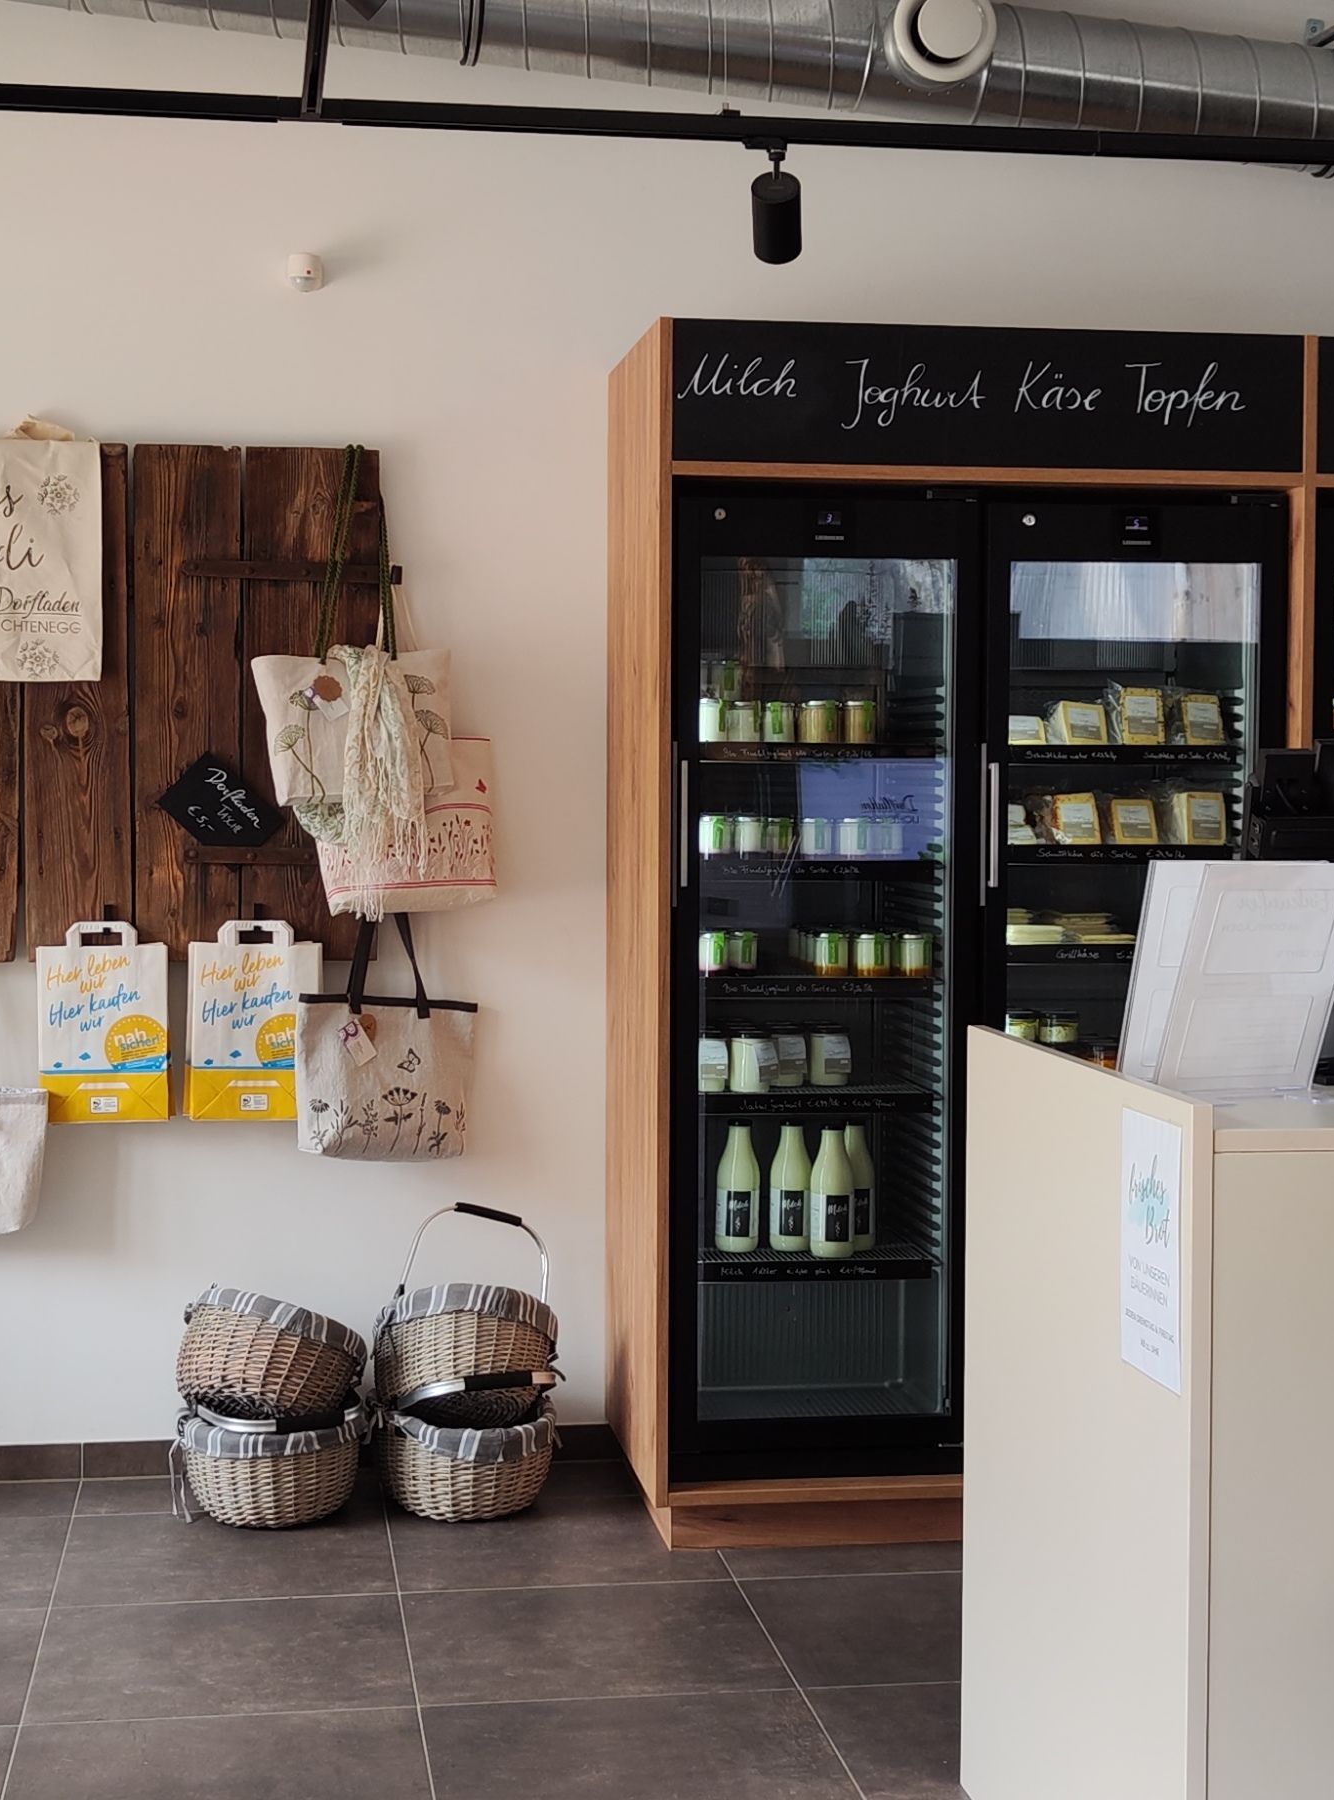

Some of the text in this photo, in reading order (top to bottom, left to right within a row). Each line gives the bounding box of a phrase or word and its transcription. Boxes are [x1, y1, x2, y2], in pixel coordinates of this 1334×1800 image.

[677, 353, 1245, 429] Milch Joghurt Käse Topfen
[204, 767, 261, 830] Dorfladen
[46, 952, 131, 990] Hier leben
[79, 975, 107, 994] wir
[200, 951, 284, 988] Hier leben
[233, 974, 260, 993] wir
[49, 983, 141, 1028] Hier kaufen
[202, 982, 293, 1026] Hier kaufen
[231, 1012, 257, 1030] wir
[80, 1014, 104, 1033] wir
[114, 1028, 146, 1047] nah
[1145, 1206, 1171, 1248] Brot
